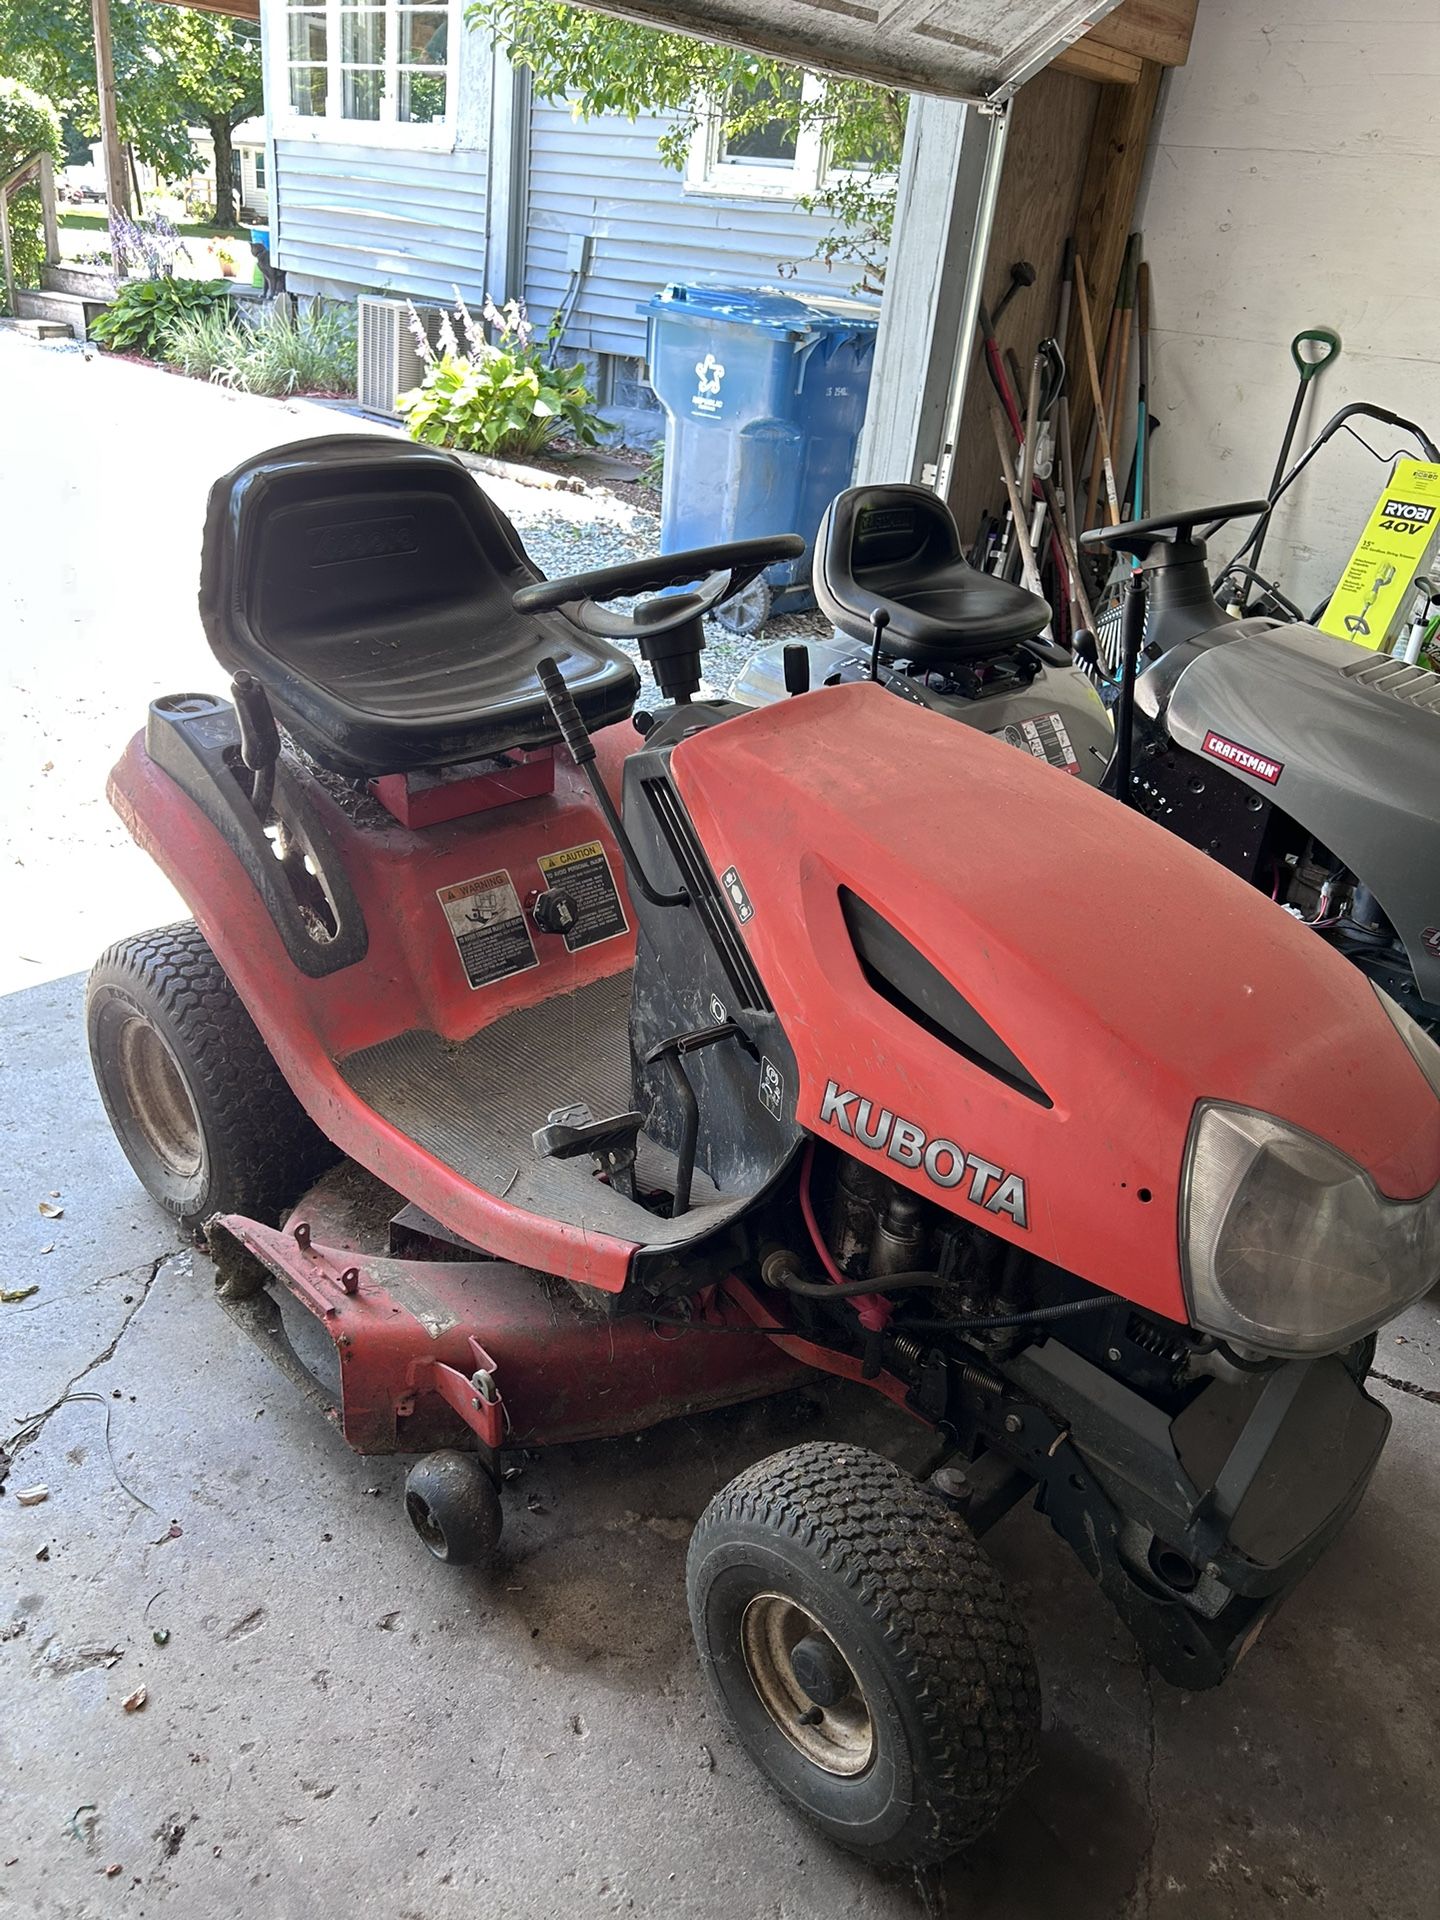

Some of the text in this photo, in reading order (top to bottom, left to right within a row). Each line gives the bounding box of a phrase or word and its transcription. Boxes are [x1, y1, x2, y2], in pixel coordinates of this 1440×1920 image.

[1384, 502, 1433, 522] RYOBI
[1379, 519, 1425, 535] 40V
[1208, 737, 1275, 778] CRAFTSMAN
[559, 846, 596, 864] CAUTION
[460, 875, 504, 896] WARNING
[819, 1079, 1029, 1230] KUBOTA
